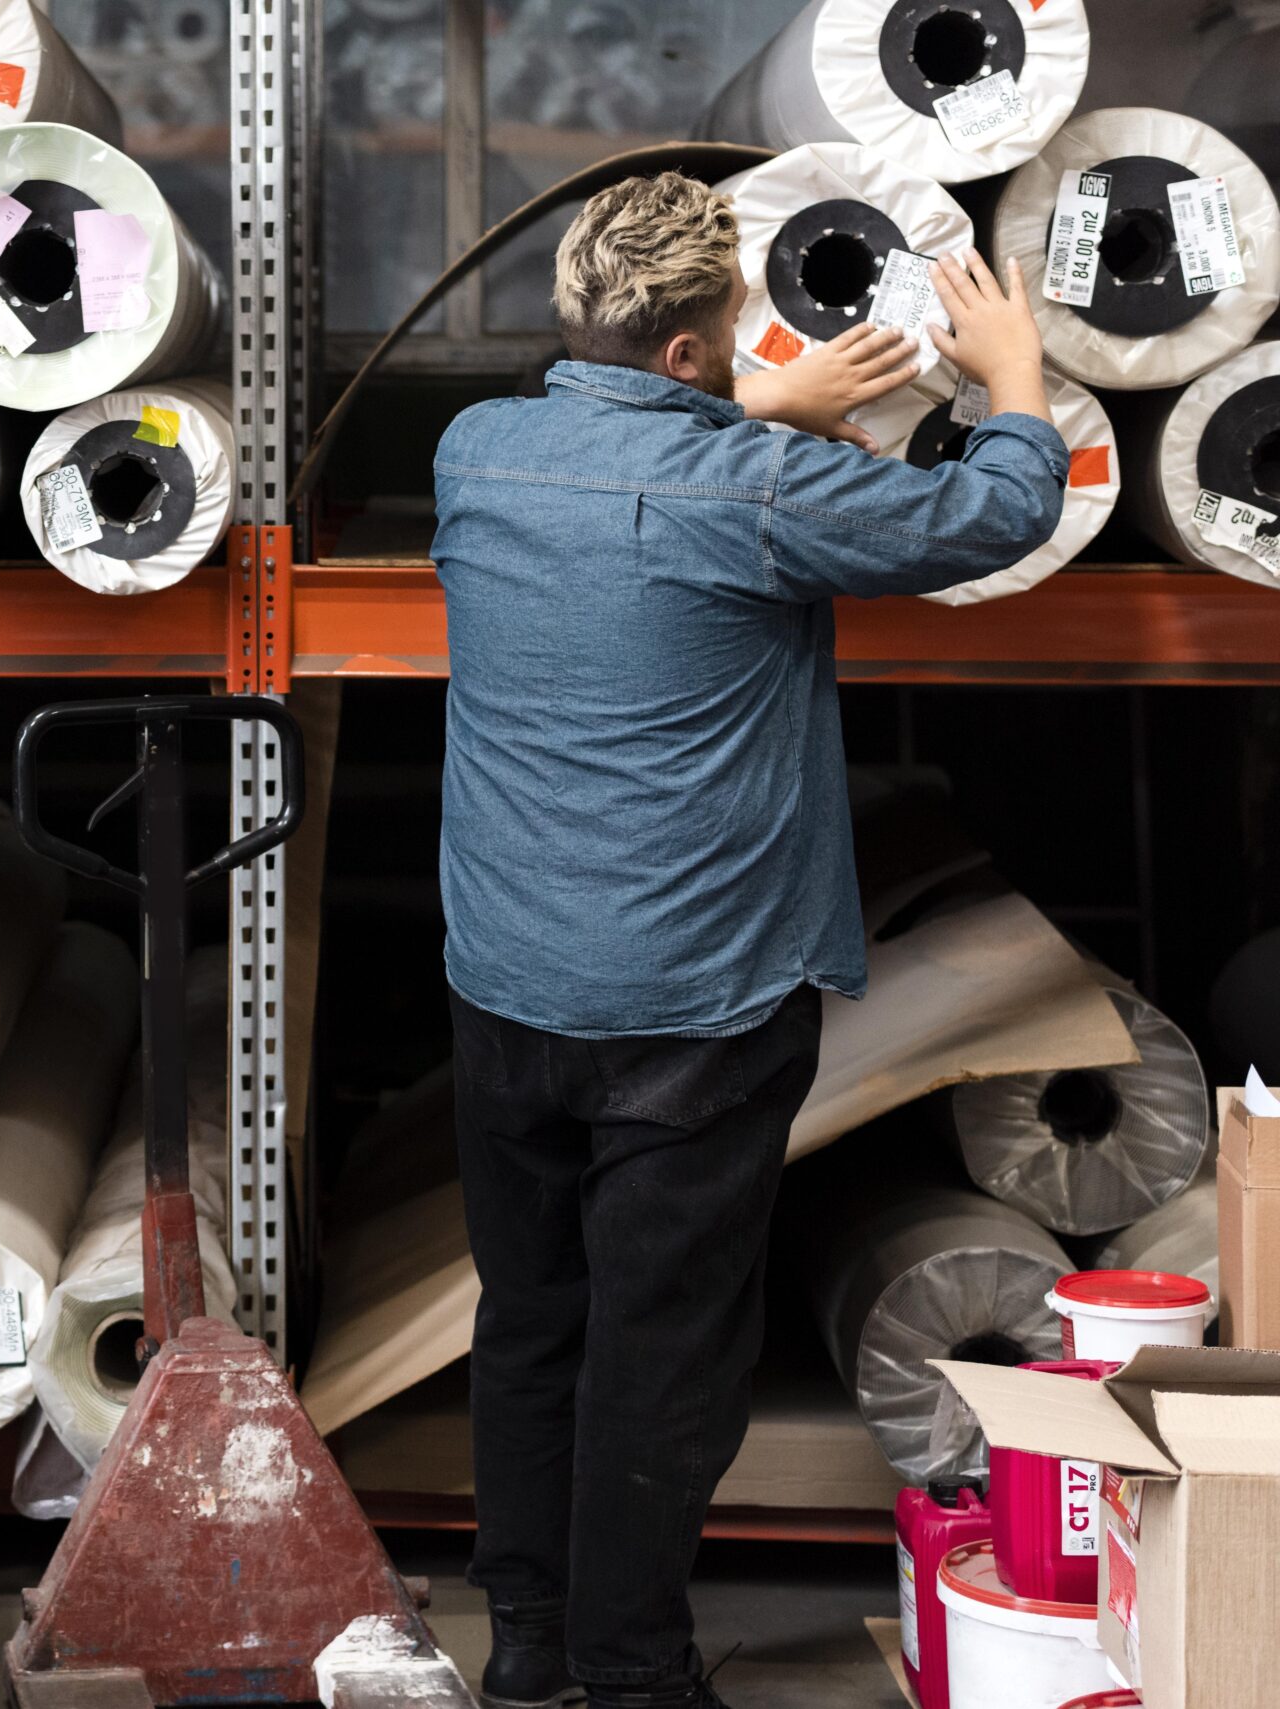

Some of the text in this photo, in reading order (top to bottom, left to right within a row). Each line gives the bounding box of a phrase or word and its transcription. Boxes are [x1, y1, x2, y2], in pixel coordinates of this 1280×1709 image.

[998, 87, 1020, 105] 75
[1081, 175, 1106, 196] 1GV6
[4, 210, 15, 222] 41
[1079, 209, 1098, 233] m2
[1200, 196, 1215, 225] LONDON
[1217, 202, 1237, 256] MEGAPOLIS
[1051, 246, 1069, 276] LONDON
[1071, 238, 1094, 279] 84,00
[1049, 276, 1065, 288] ME
[1192, 276, 1213, 293] 1GV6
[906, 267, 933, 330] -483Mn
[48, 471, 64, 491] 60
[62, 466, 94, 532] 30-713Mn
[1231, 507, 1255, 525] m2
[2, 1287, 19, 1351] 30-448Mn
[1068, 1466, 1089, 1532] CT 17
